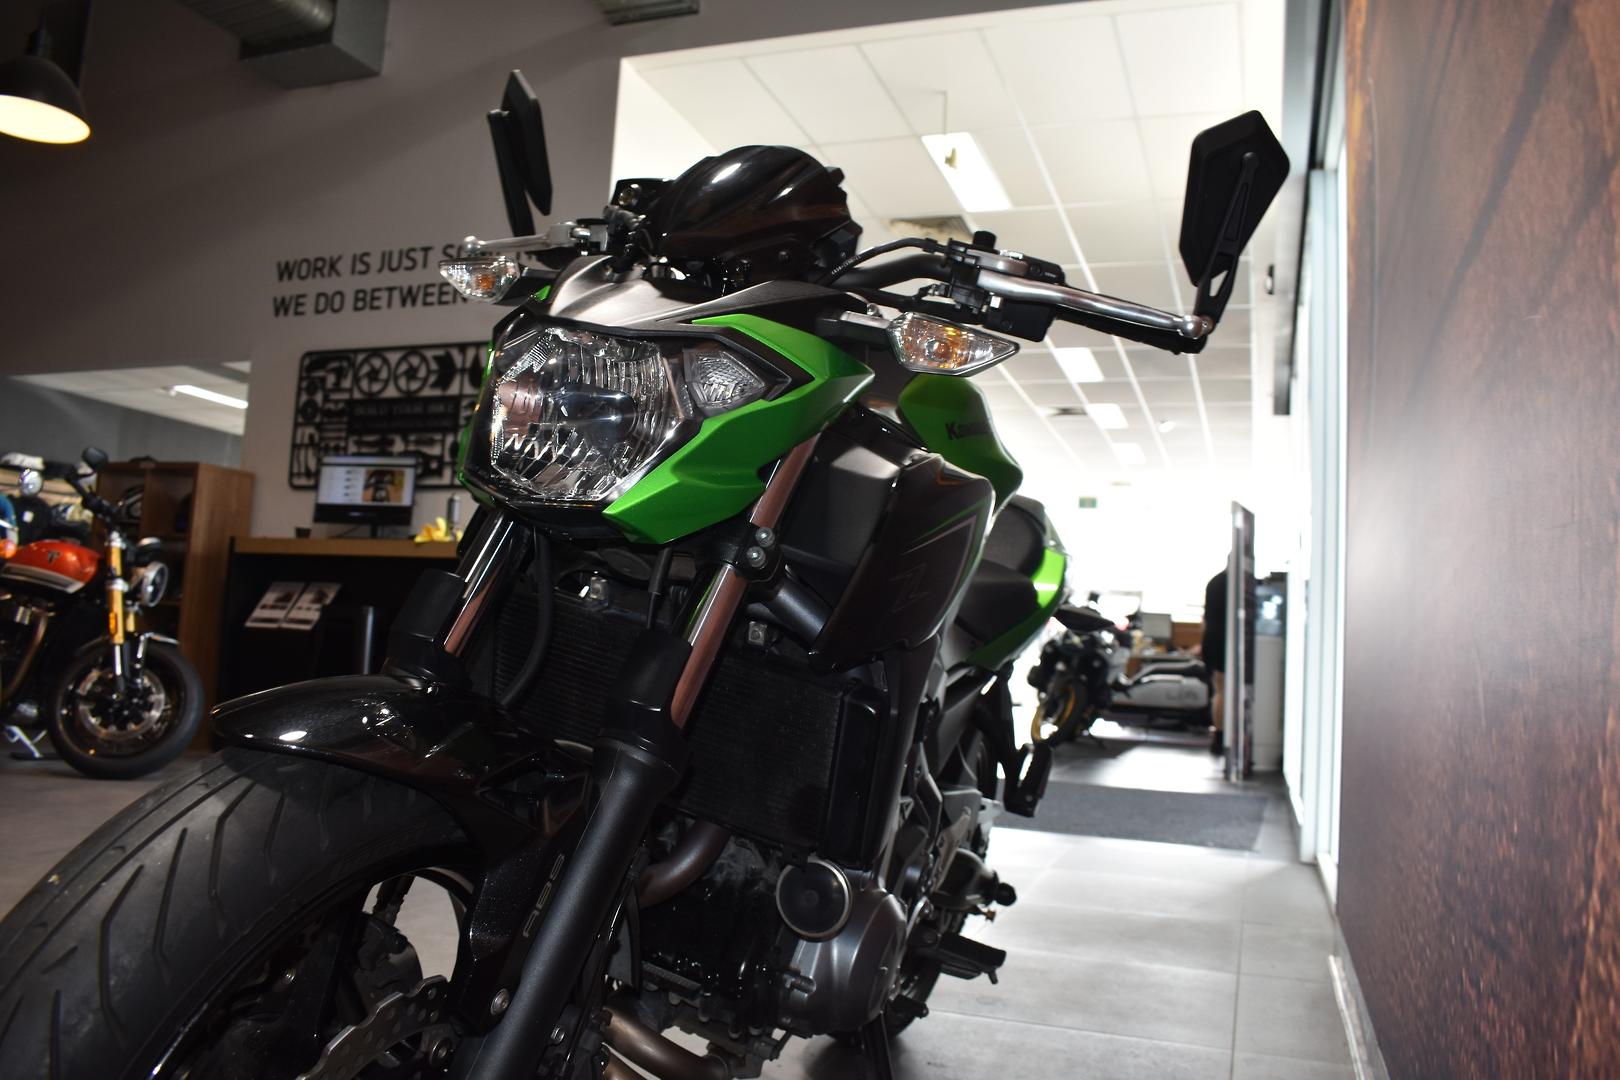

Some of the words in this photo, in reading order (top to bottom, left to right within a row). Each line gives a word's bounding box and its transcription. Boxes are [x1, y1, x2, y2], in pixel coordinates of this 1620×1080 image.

[276, 254, 343, 282] WORK
[350, 251, 371, 276] IS
[377, 246, 433, 273] JUST
[272, 293, 307, 318] WE
[314, 290, 345, 315] DO
[522, 851, 566, 938] ABS
